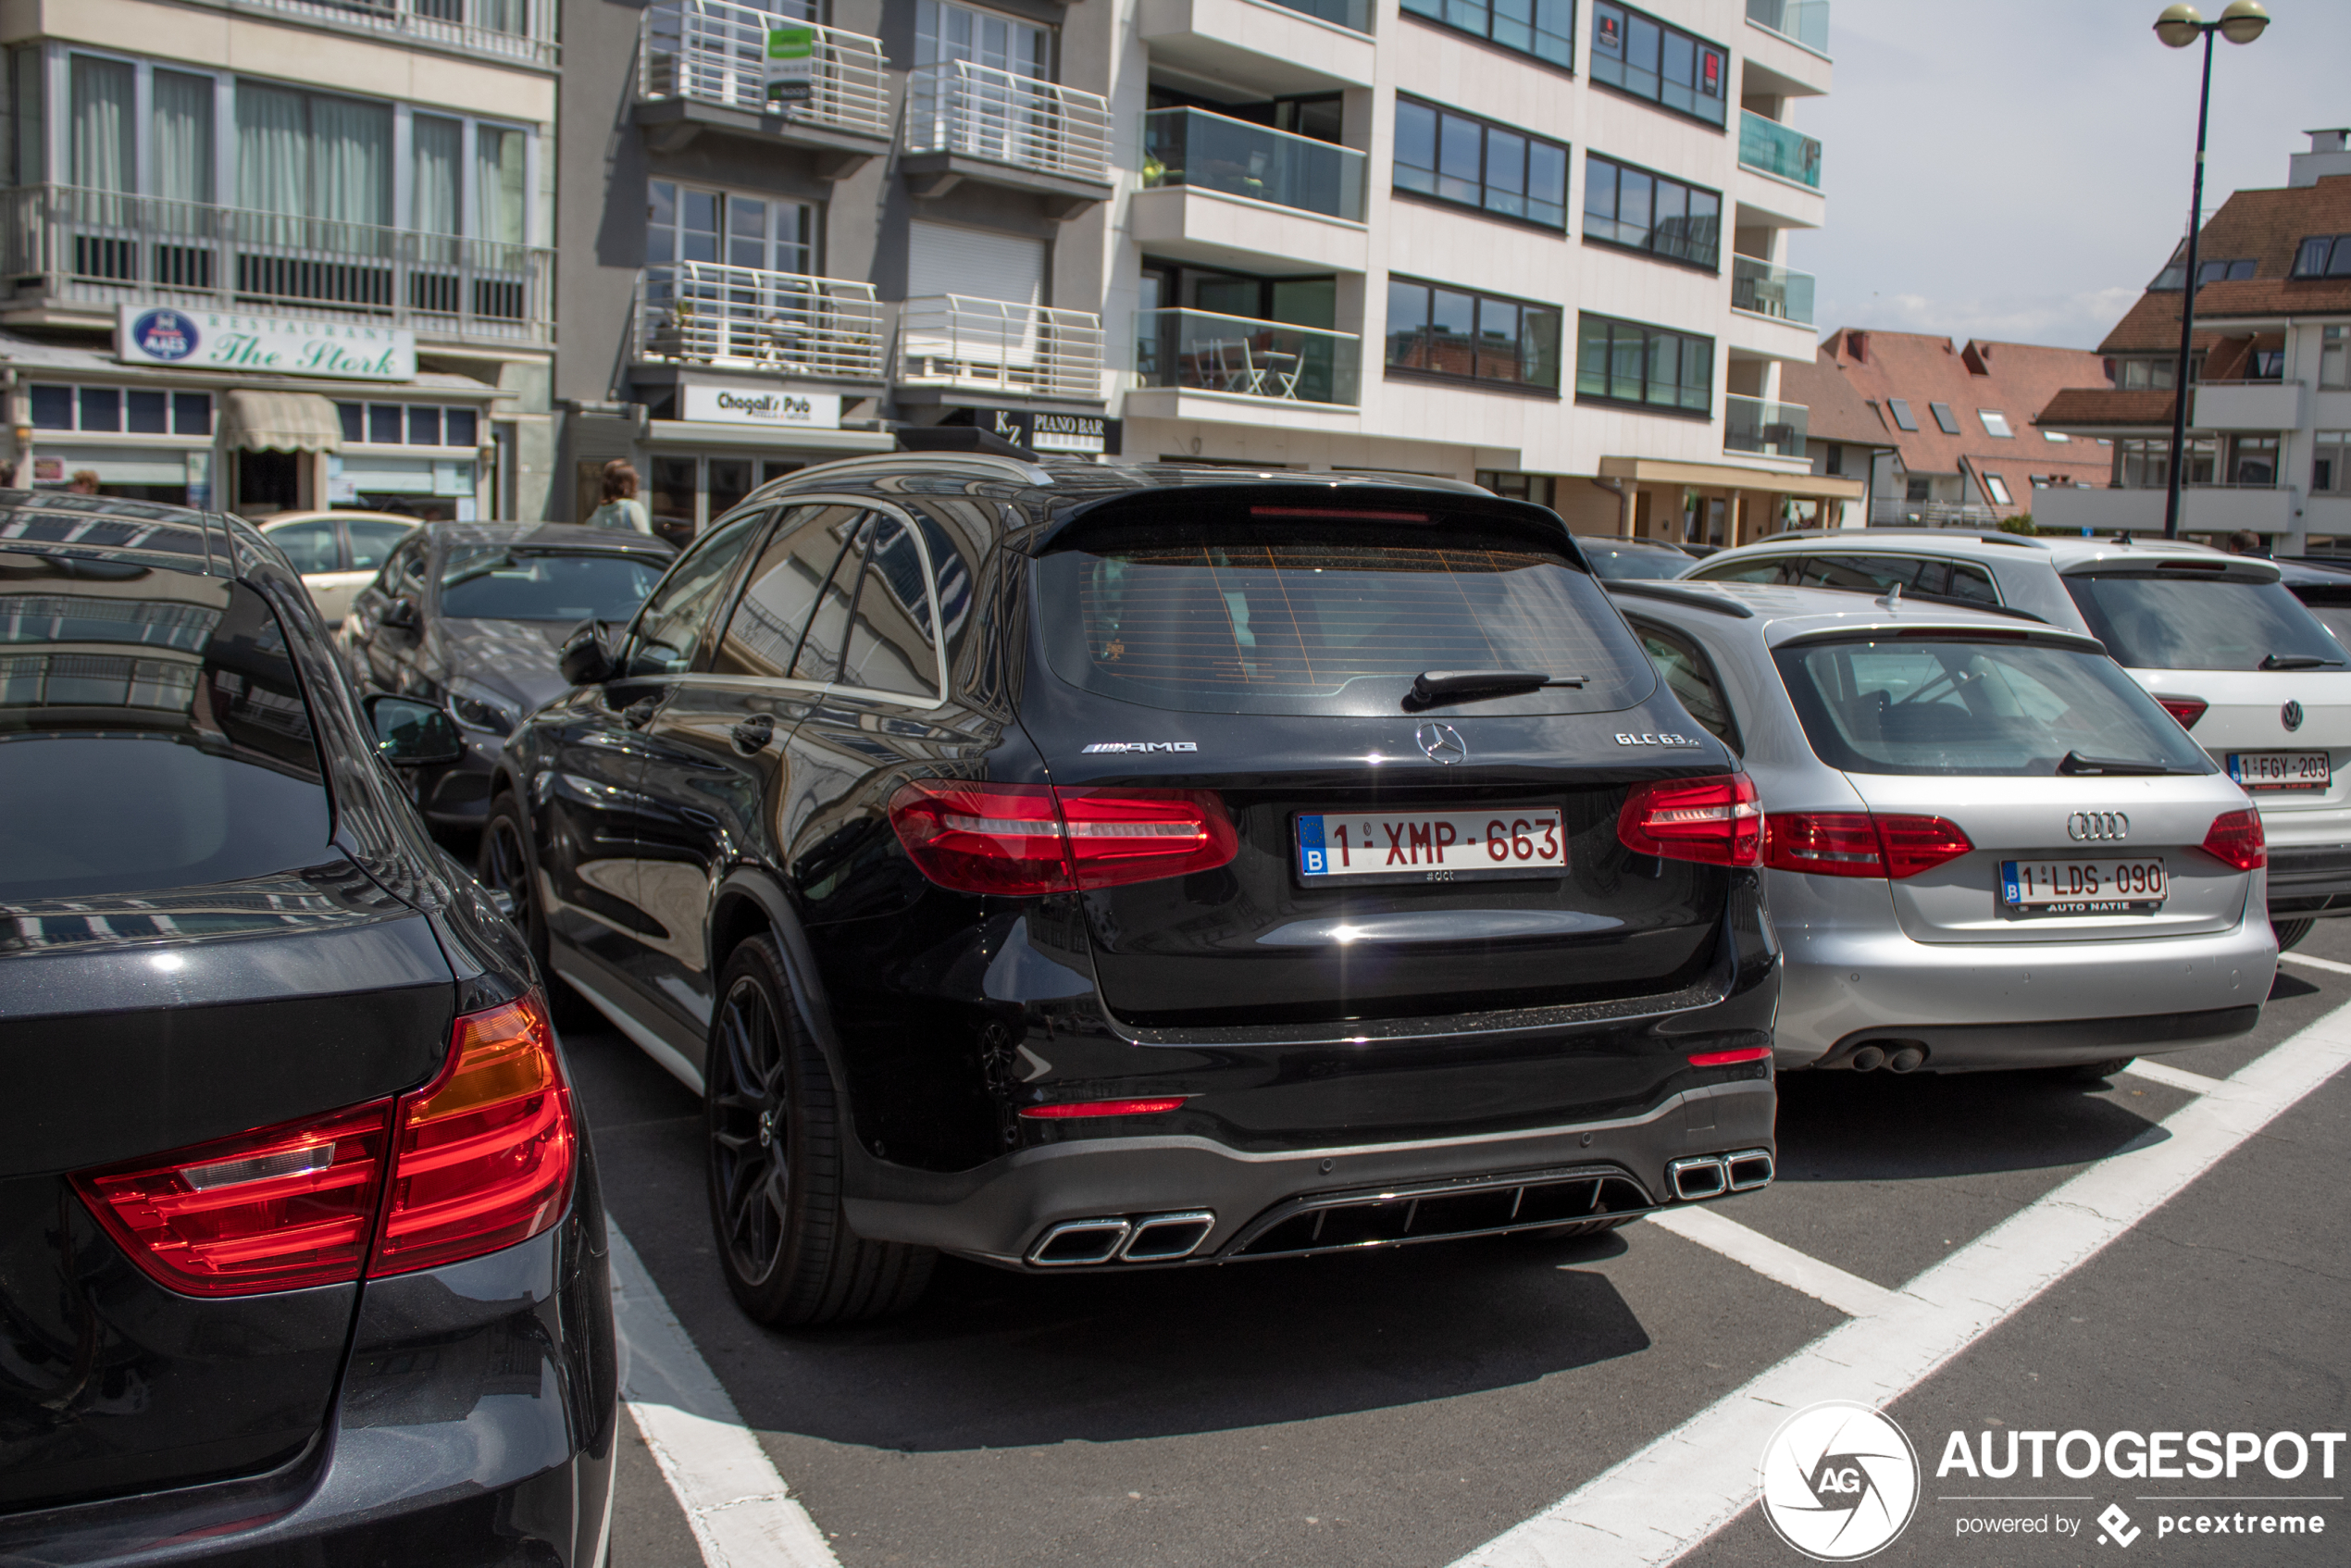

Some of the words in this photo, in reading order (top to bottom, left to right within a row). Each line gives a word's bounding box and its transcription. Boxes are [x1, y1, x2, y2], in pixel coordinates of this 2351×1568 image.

[207, 313, 397, 342] RESTAURANT
[143, 337, 188, 353] MAES
[209, 331, 281, 367] The
[295, 338, 396, 376] Stork
[717, 391, 779, 416] Chagall's
[784, 396, 812, 413] Pub
[1033, 414, 1076, 433] PIANO
[1077, 417, 1105, 436] BAR
[1614, 733, 1658, 746] GLC
[1307, 851, 1324, 871] B
[2007, 884, 2019, 901] B
[2046, 903, 2085, 913] AUTO
[2089, 902, 2130, 912] NATIE
